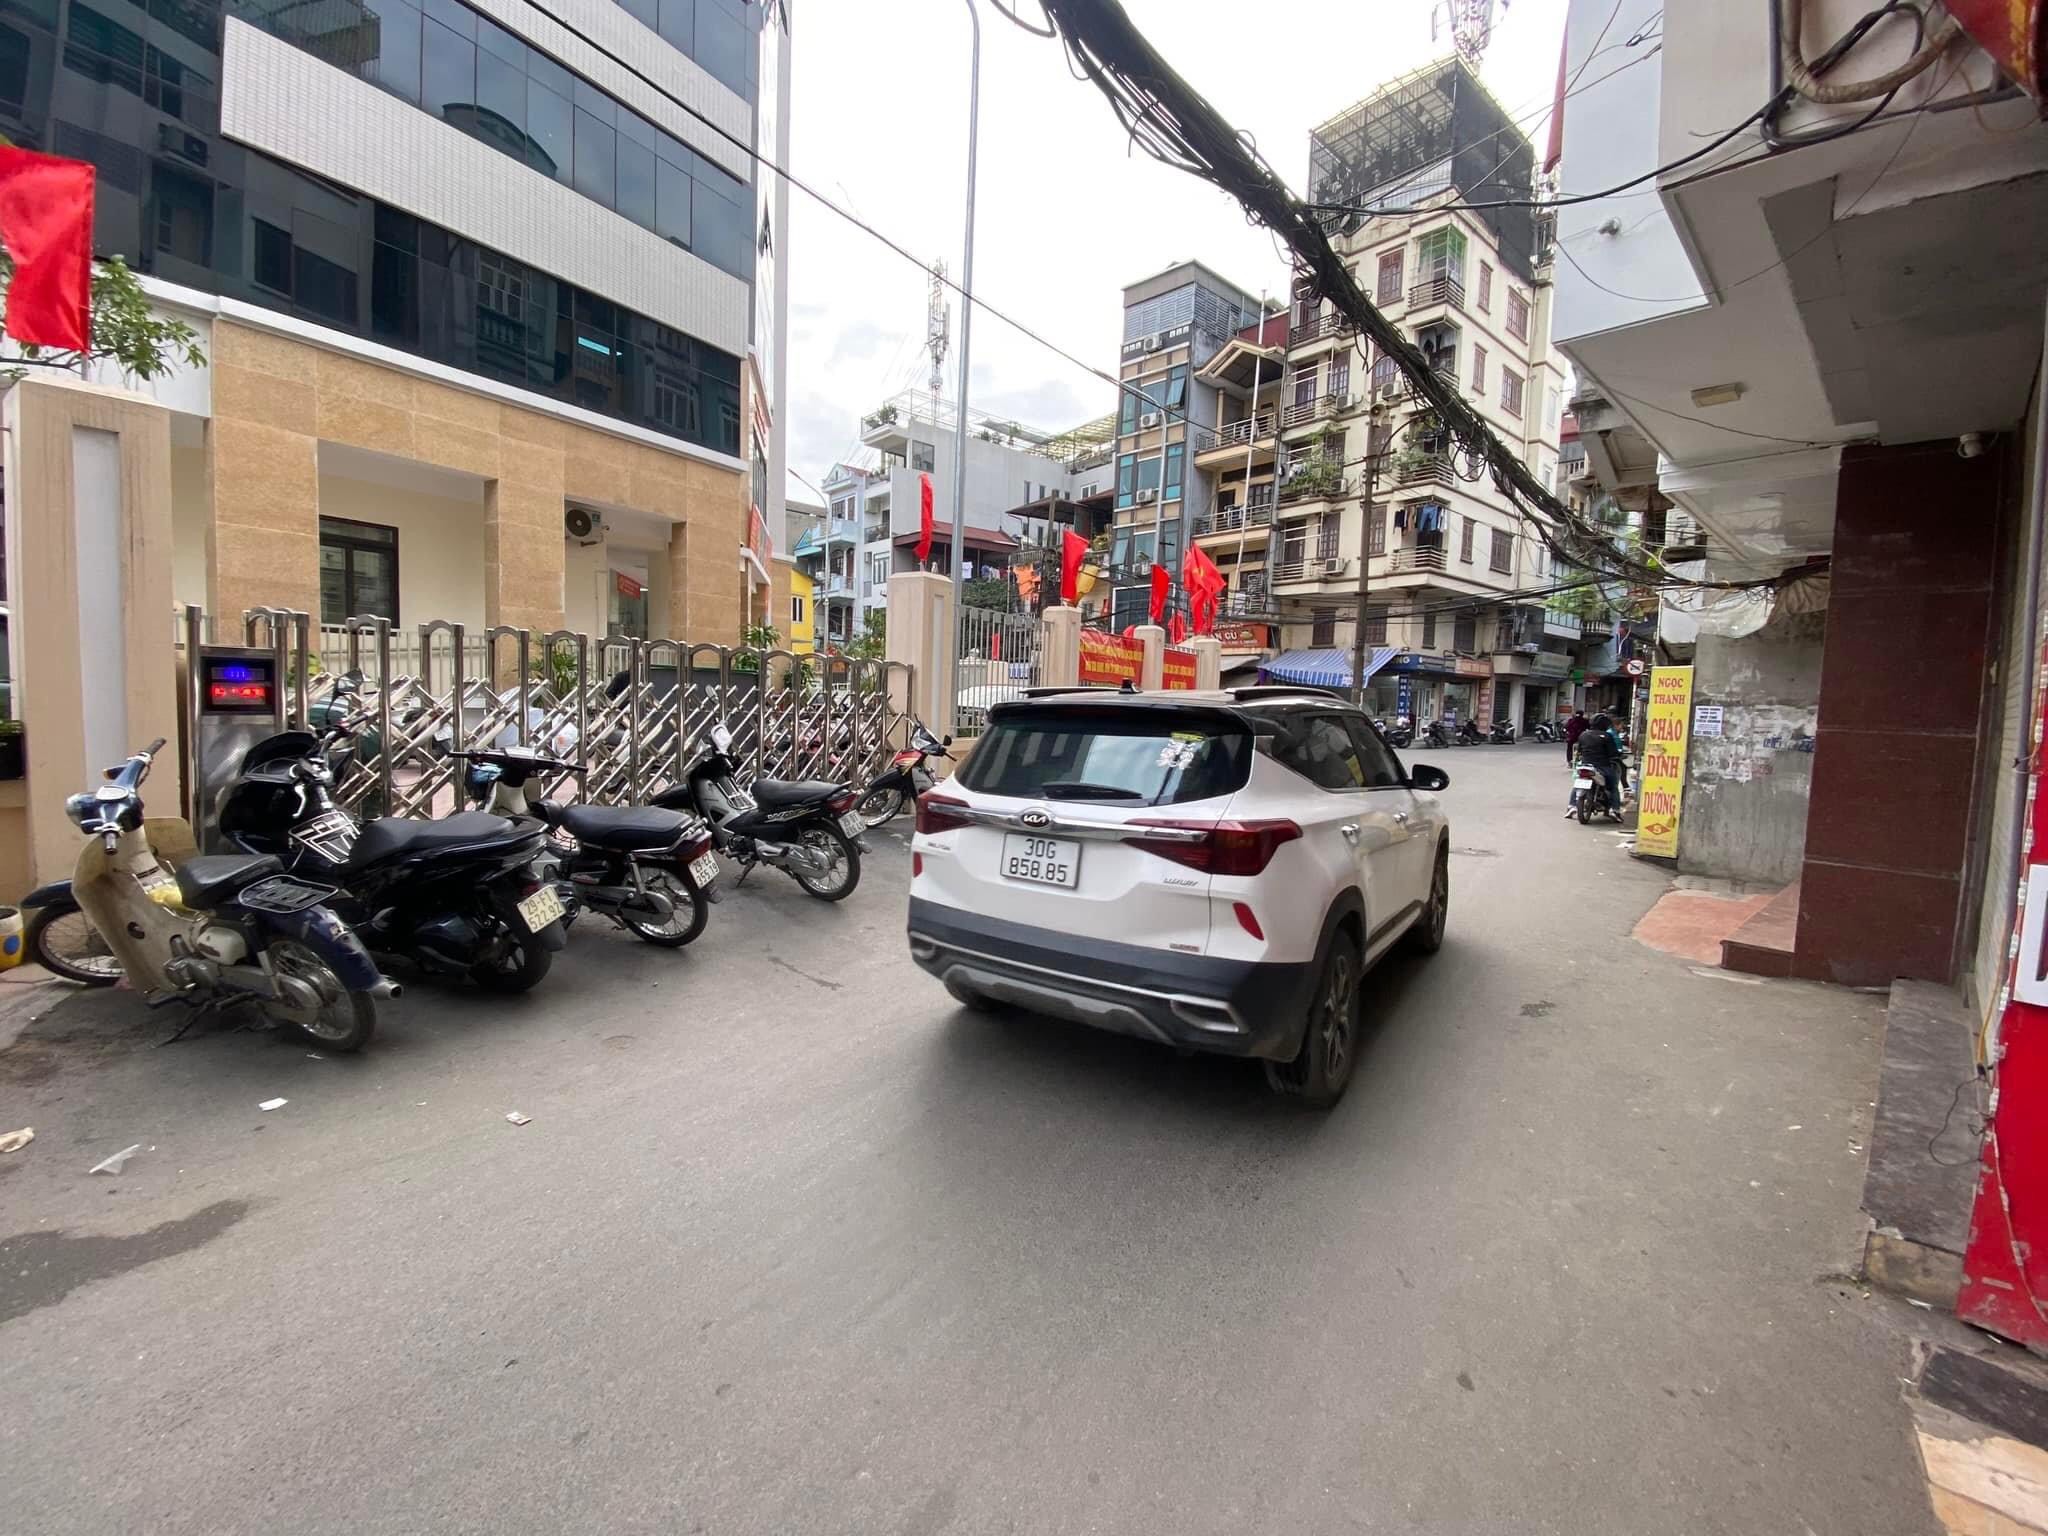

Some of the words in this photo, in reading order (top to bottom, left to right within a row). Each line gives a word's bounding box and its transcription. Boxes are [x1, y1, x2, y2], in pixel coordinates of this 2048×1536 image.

[1657, 677, 1683, 690] NGỌC
[1654, 694, 1686, 704] THANH
[1024, 814, 1046, 823] KIA
[1024, 838, 1056, 859] 30G
[1009, 857, 1068, 882] 858.85
[524, 890, 553, 915] 29-F1
[528, 902, 563, 929] 522.92
